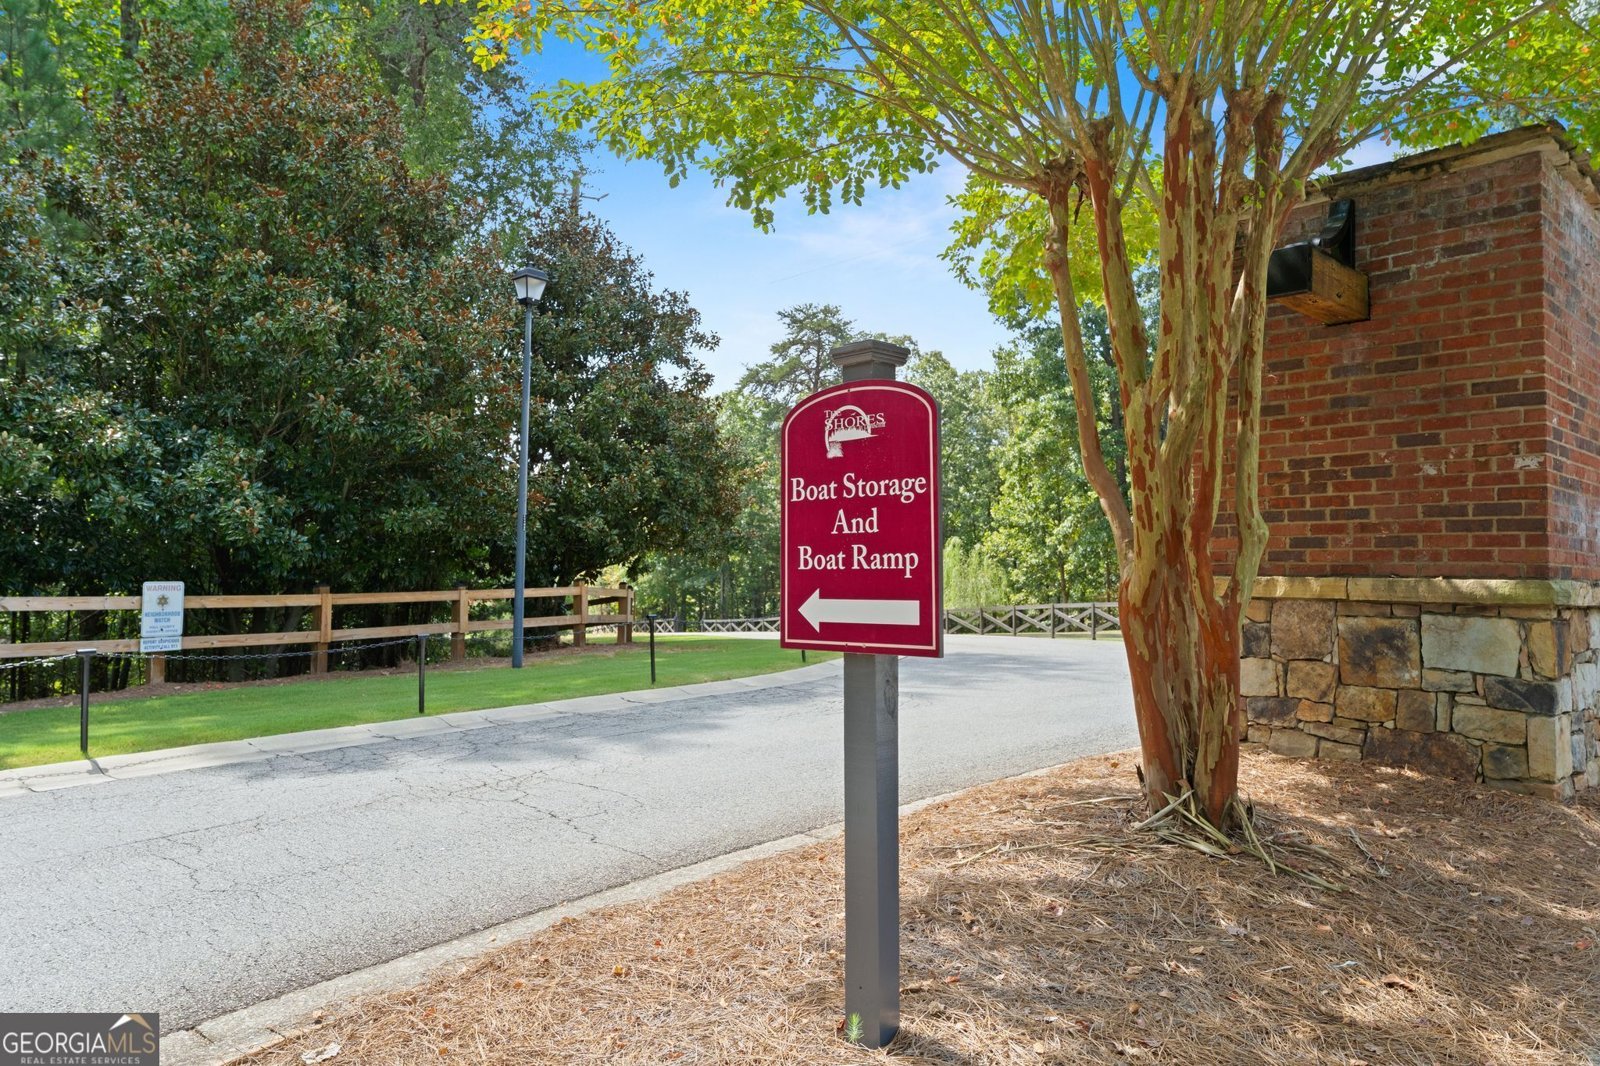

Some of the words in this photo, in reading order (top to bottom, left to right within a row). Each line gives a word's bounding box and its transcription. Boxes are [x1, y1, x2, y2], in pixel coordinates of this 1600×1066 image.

[824, 413, 885, 431] SHORES
[790, 477, 837, 502] Boat
[843, 473, 927, 504] Storage
[831, 507, 879, 534] And
[798, 545, 846, 570] Boat
[851, 544, 919, 578] Ramp
[145, 584, 182, 592] WARNING
